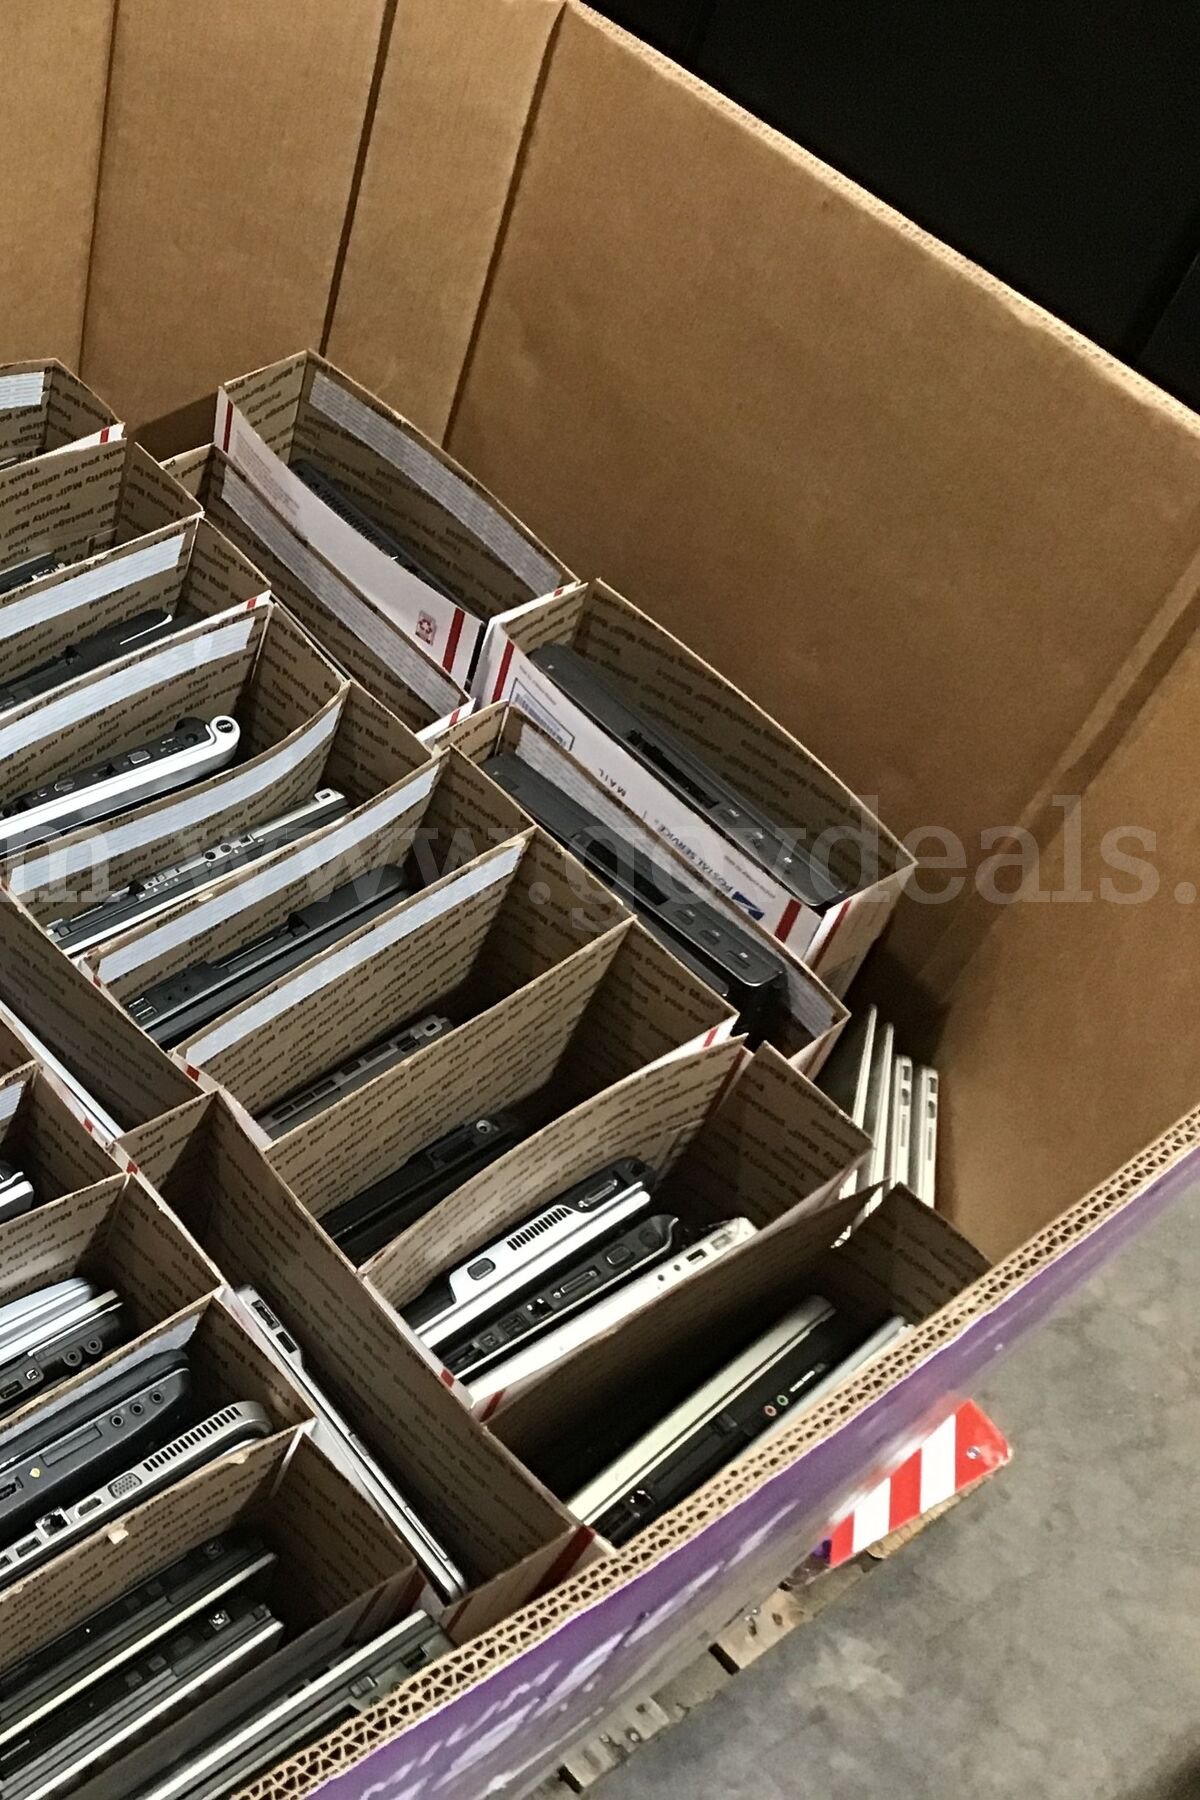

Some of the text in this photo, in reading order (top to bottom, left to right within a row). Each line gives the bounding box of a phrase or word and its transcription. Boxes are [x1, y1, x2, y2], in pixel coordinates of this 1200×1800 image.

[64, 466, 78, 476] for
[81, 456, 100, 470] you
[8, 467, 40, 483] Thank
[32, 474, 60, 490] using
[14, 494, 53, 515] Service
[33, 502, 71, 523] Priority
[8, 509, 94, 551] postage required
[0, 546, 30, 563] Thank
[98, 709, 128, 729] Thank
[6, 728, 76, 774] Thank you for
[597, 767, 626, 797] MAIL
[697, 858, 733, 892] POSTAL
